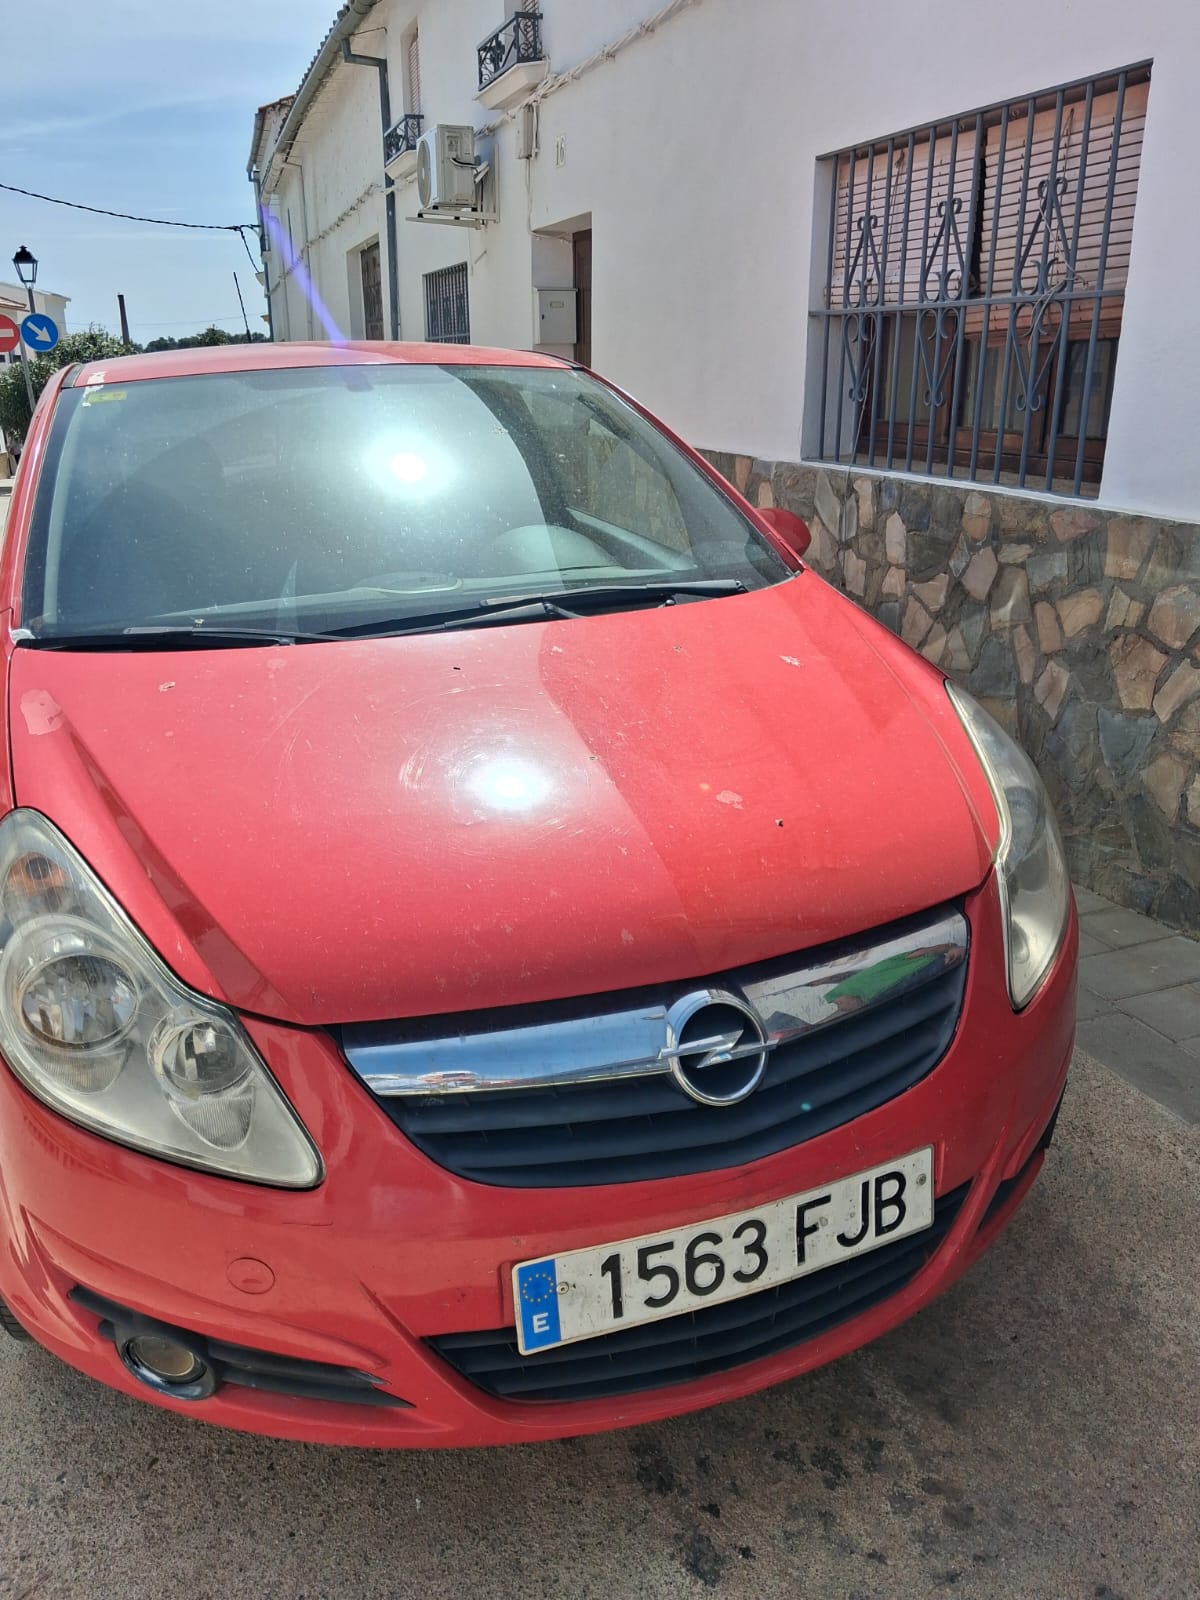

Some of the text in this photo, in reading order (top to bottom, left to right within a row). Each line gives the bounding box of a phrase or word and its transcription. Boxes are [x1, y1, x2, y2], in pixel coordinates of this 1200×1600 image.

[600, 1170, 907, 1319] 1563 FJB
[532, 1312, 550, 1334] E
